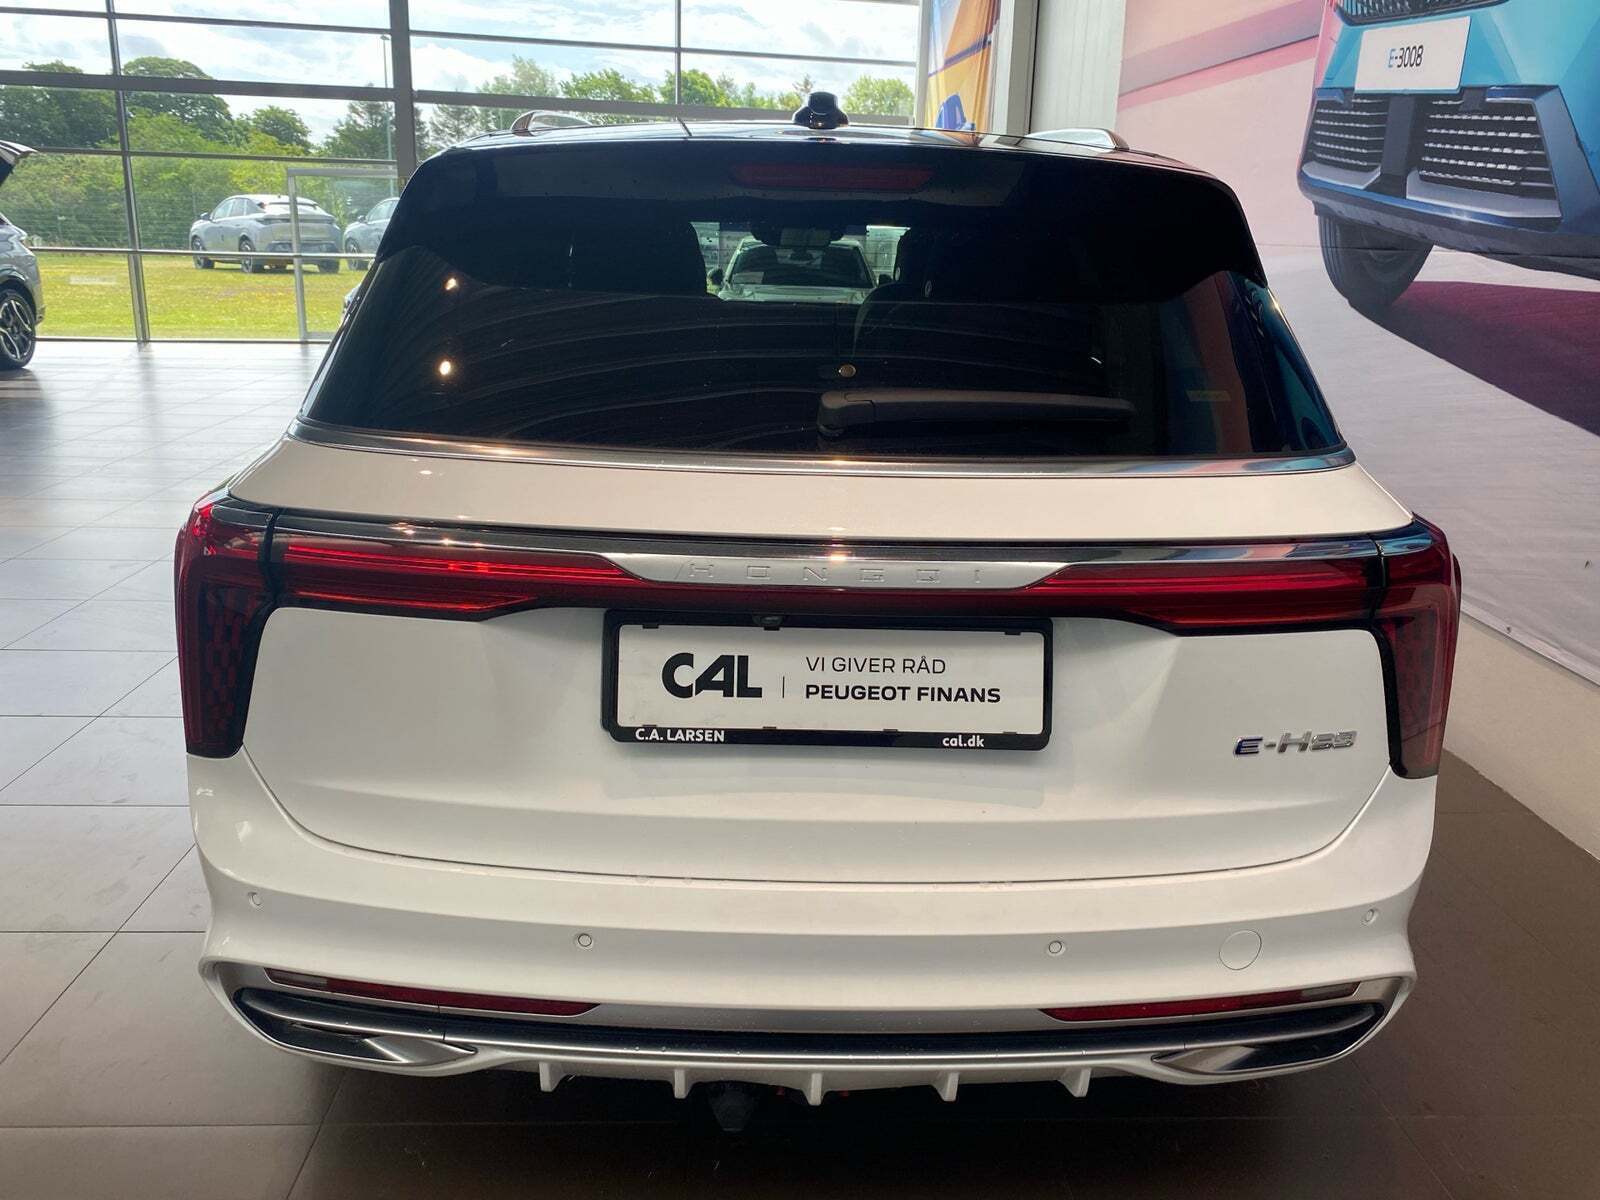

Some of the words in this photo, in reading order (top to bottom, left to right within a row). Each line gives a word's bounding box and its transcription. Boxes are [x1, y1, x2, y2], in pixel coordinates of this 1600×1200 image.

[1388, 45, 1424, 69] E-3008
[688, 562, 985, 584] HONGQI
[805, 656, 826, 673] VI
[832, 657, 896, 674] GIVER
[901, 656, 947, 674] RÅD
[662, 652, 763, 699] CAL
[805, 684, 910, 702] PEUGEOT
[917, 687, 1002, 704] FINANS
[635, 729, 664, 742] C.A.
[667, 730, 726, 743] LARSEN
[942, 735, 986, 748] cal.dk
